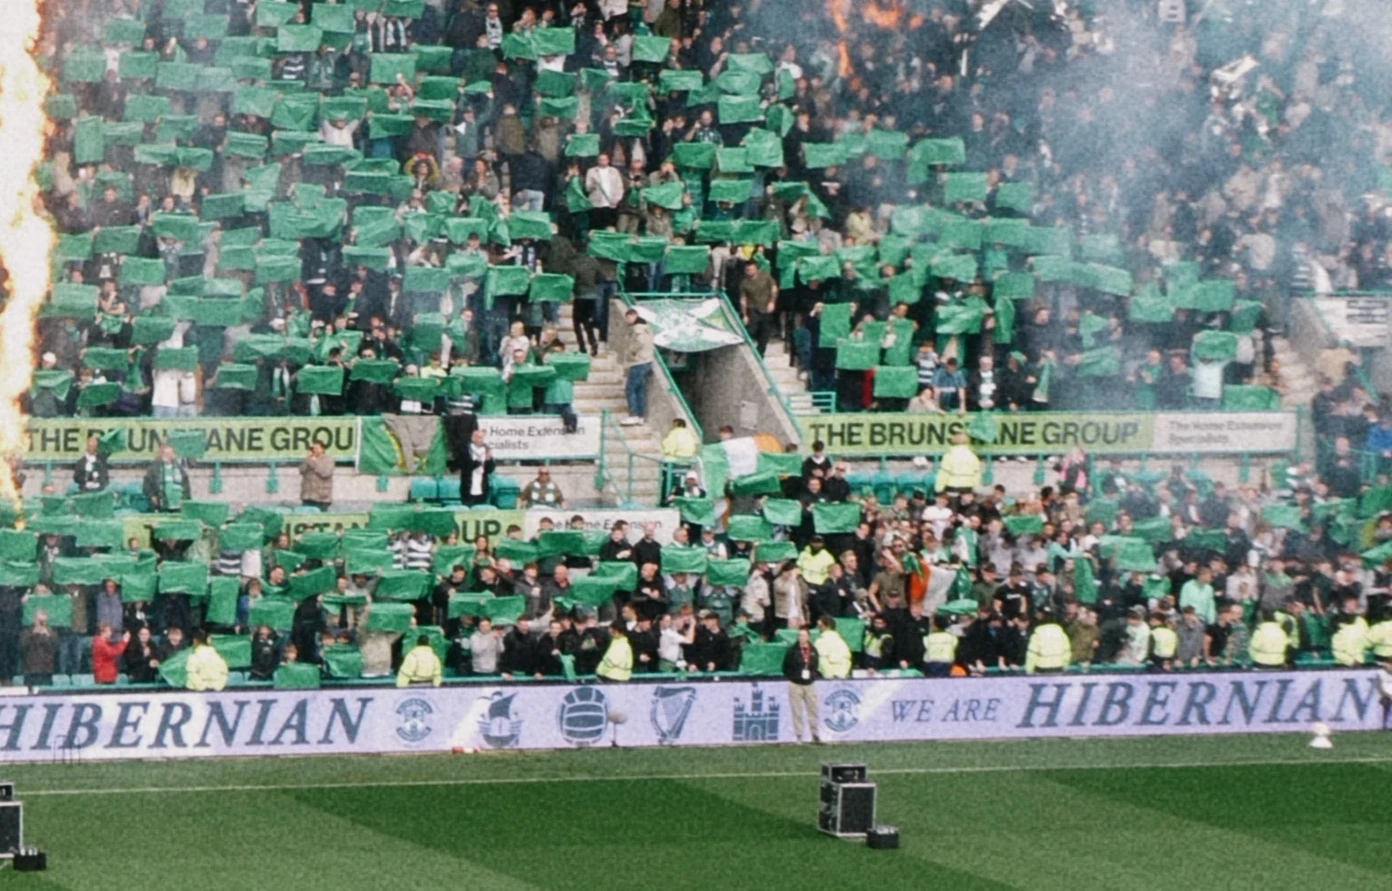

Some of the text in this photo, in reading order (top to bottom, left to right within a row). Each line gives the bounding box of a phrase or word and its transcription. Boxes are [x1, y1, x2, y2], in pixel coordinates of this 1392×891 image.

[26, 427, 81, 453] THE
[269, 426, 354, 452] GROU
[528, 426, 585, 437] Extensn
[810, 421, 1139, 446] THE BRUNSNE GROUP
[488, 440, 530, 450] cialists
[891, 677, 1380, 729] WE ARE HIBERNIAN
